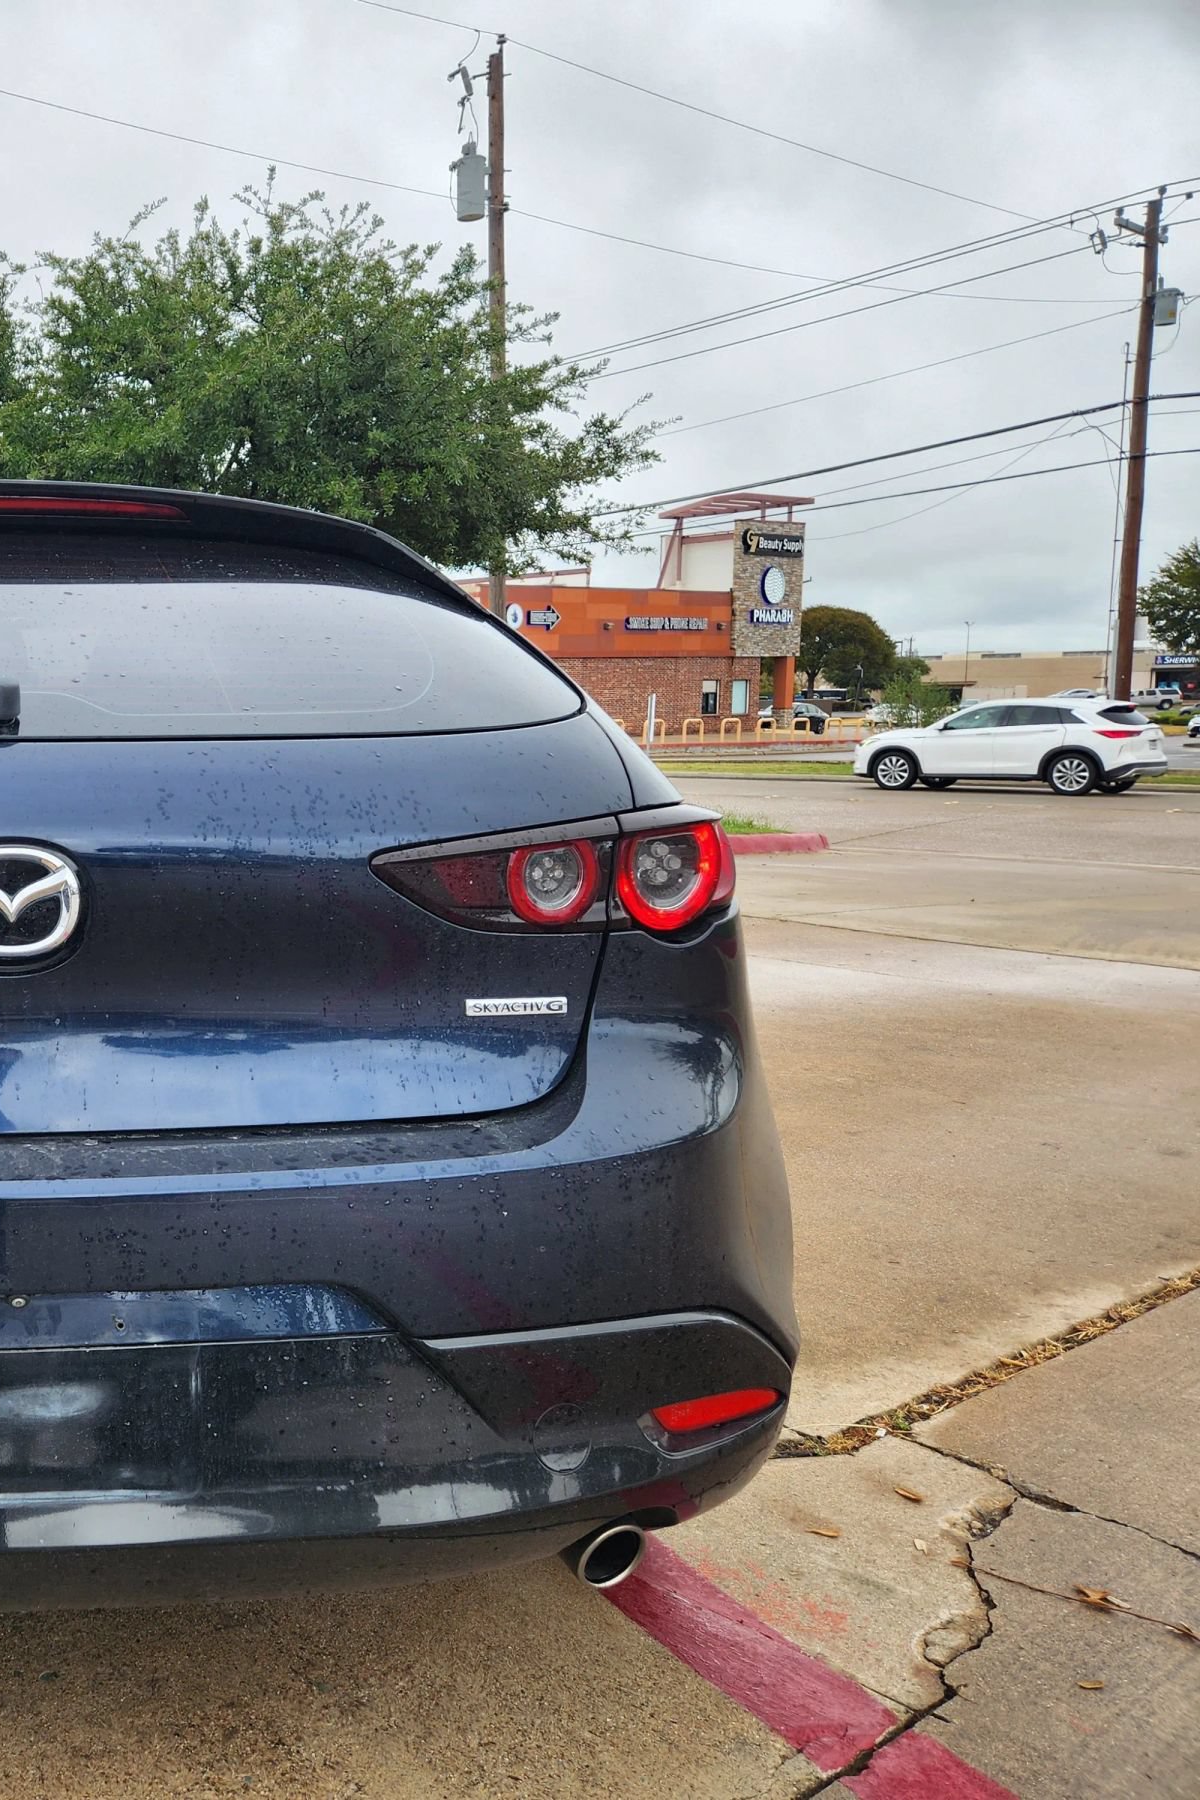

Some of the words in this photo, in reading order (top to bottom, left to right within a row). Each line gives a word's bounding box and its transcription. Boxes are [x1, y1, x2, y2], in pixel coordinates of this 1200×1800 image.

[759, 537, 783, 551] Beauty
[783, 538, 804, 554] Supply
[753, 609, 794, 622] PHARAOH
